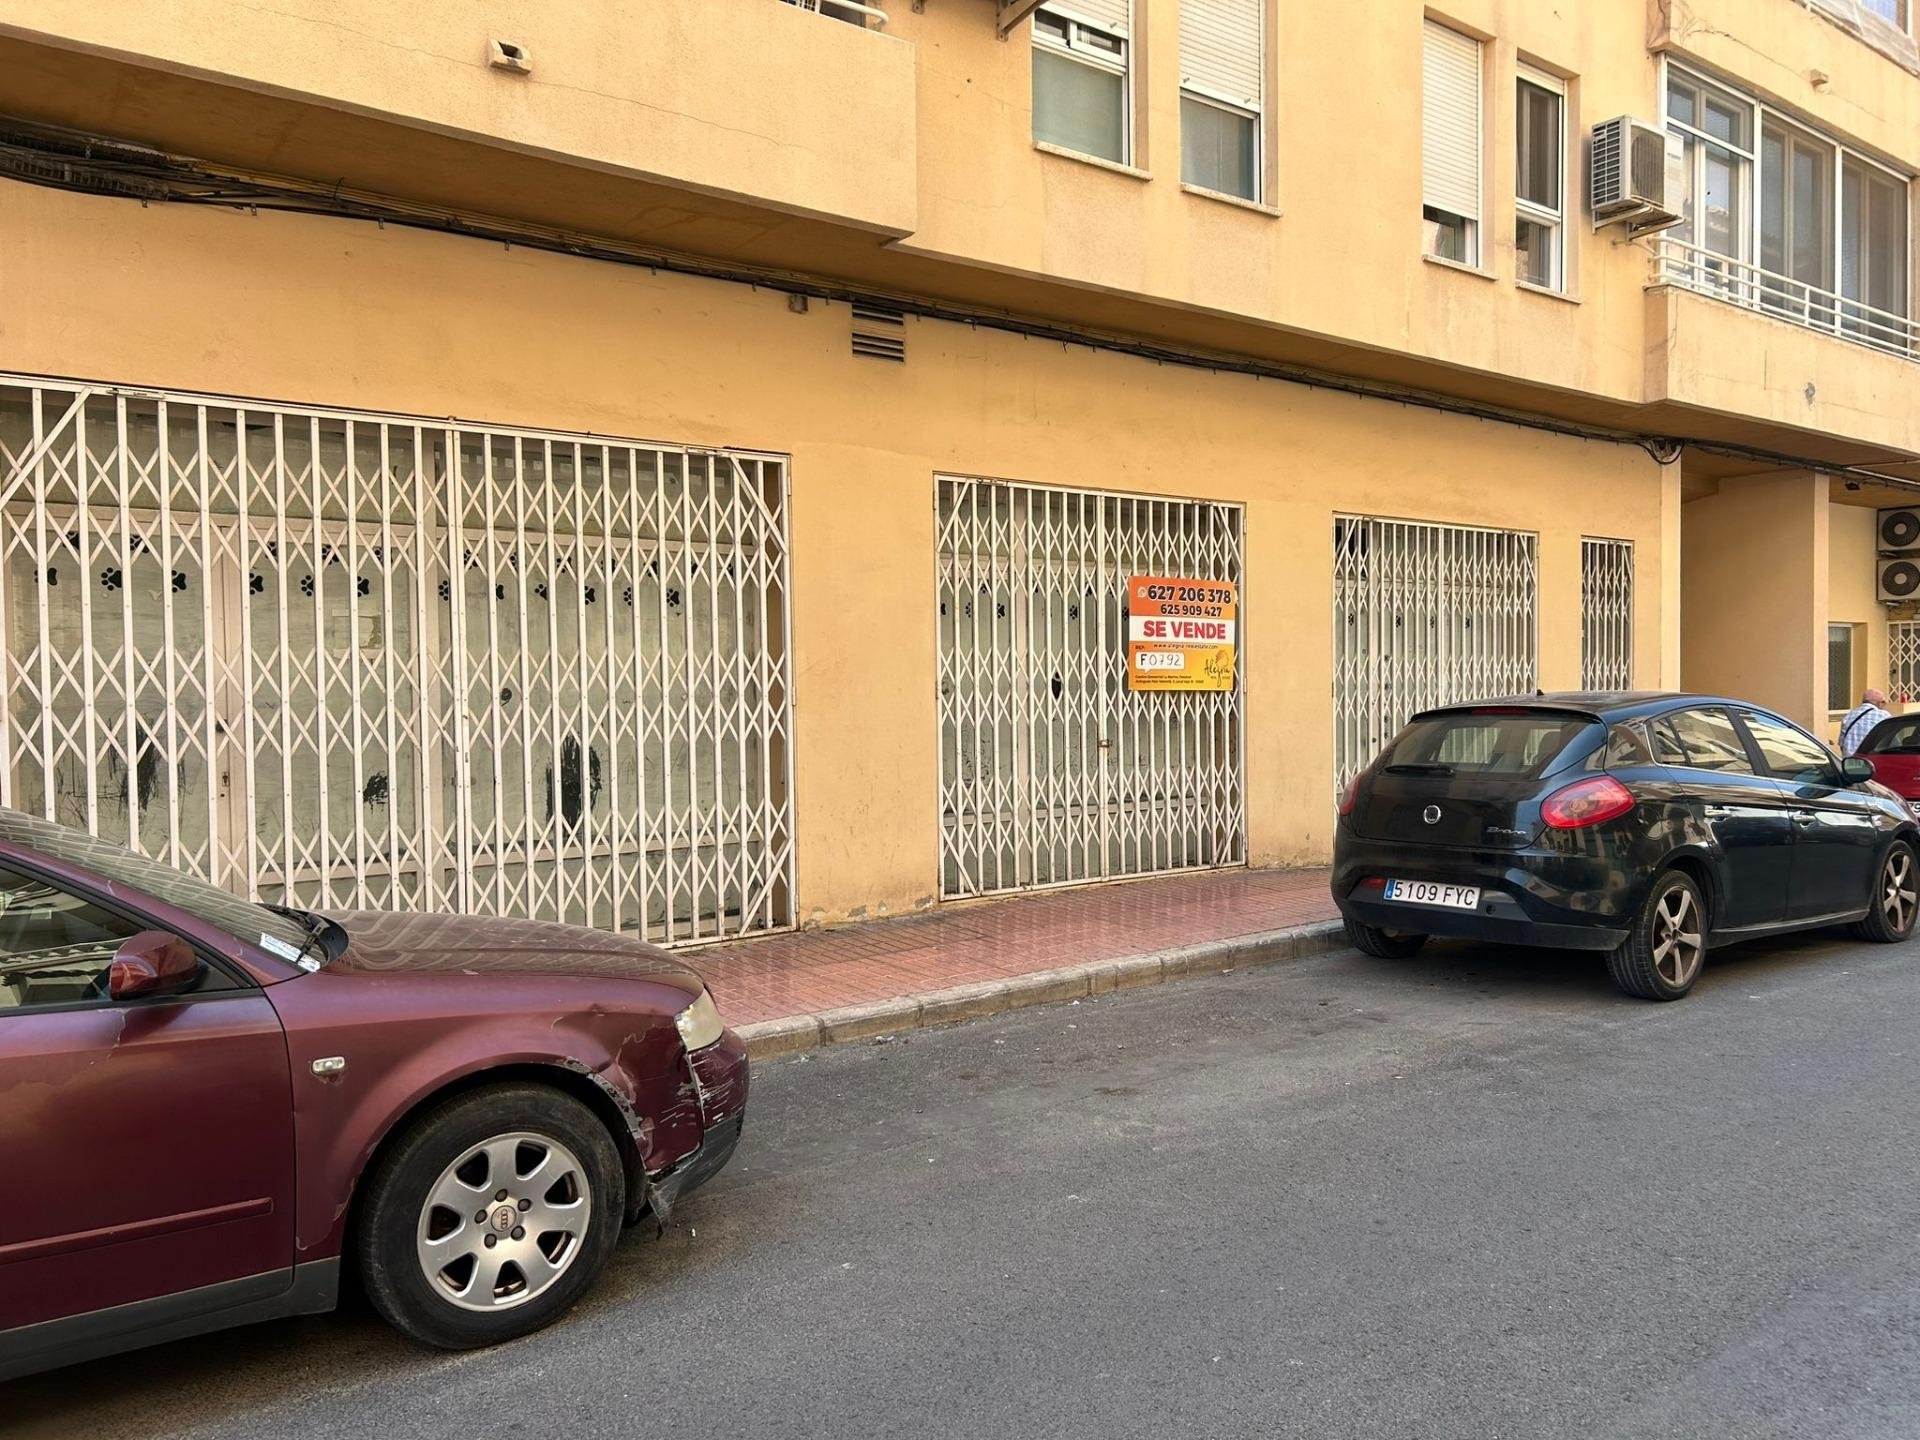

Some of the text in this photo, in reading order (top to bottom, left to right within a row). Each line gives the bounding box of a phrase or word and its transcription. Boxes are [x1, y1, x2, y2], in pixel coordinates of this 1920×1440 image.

[1148, 585, 1231, 604] 627 206 378
[1160, 604, 1222, 617] 625 909 427
[1143, 620, 1226, 640] SE VENDE
[1394, 881, 1475, 906] 5109 FYC
